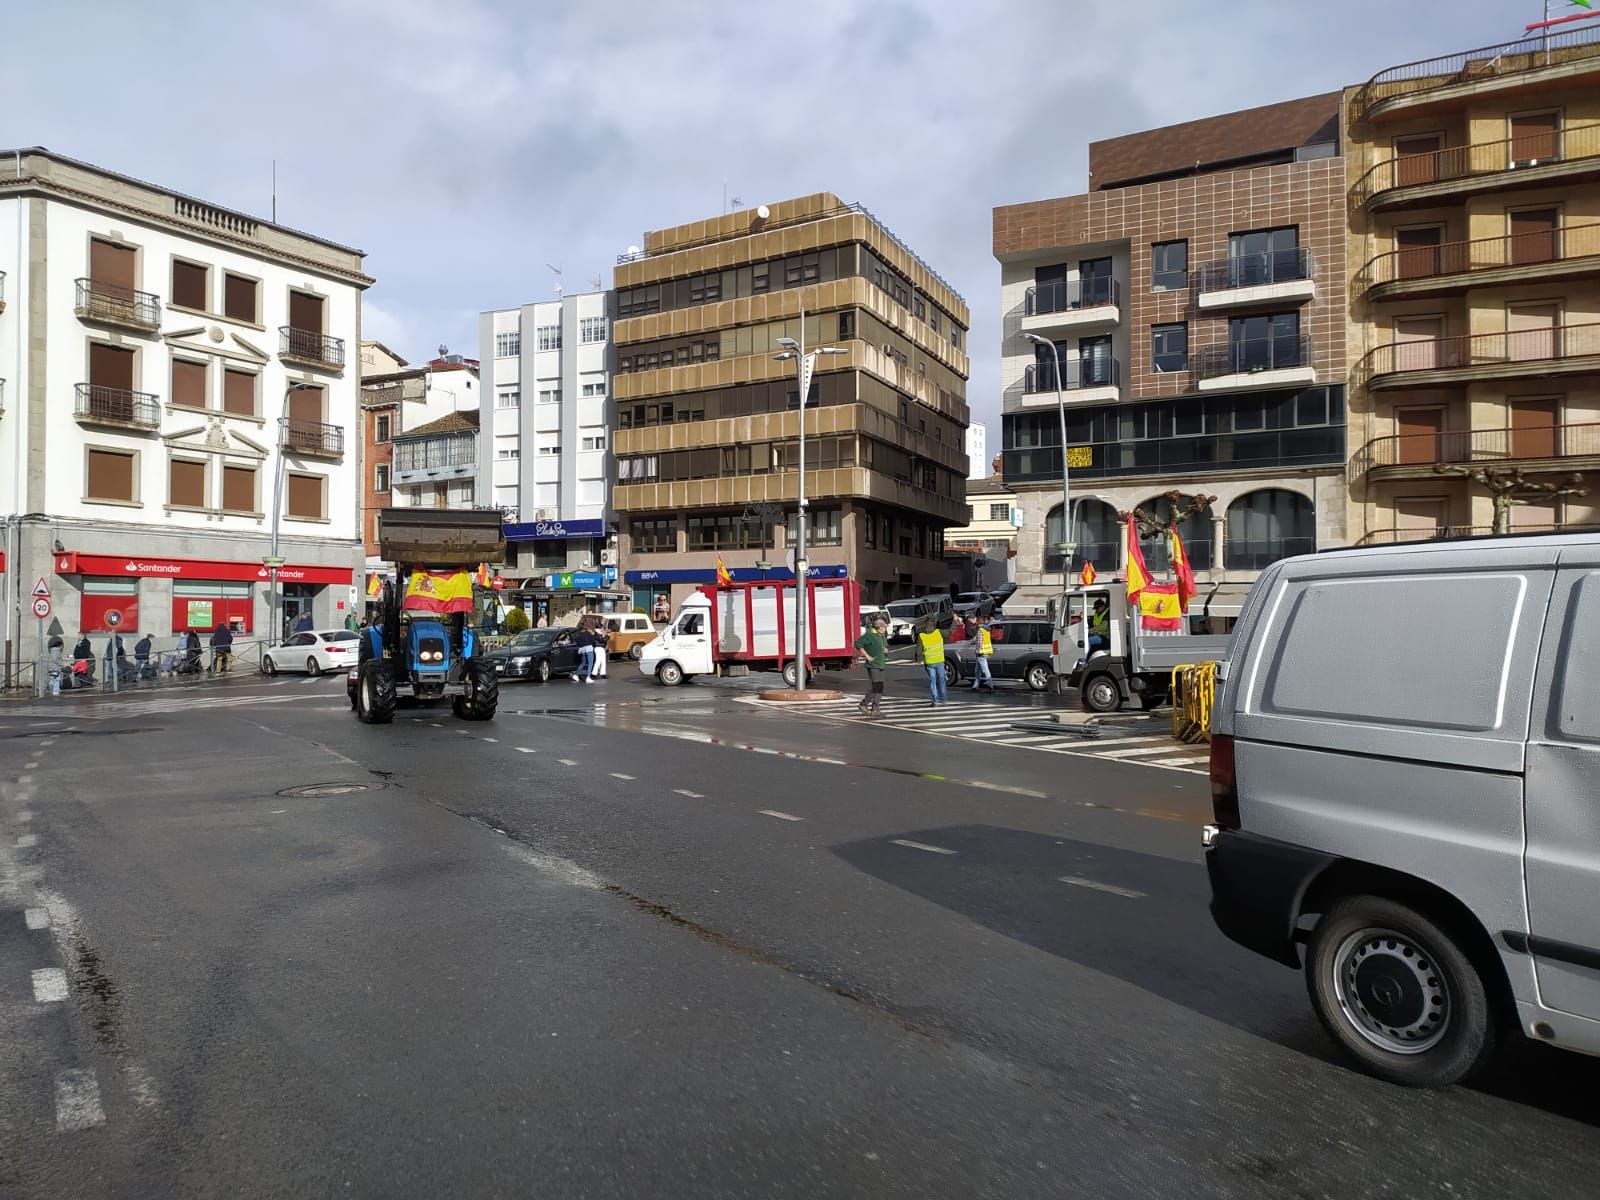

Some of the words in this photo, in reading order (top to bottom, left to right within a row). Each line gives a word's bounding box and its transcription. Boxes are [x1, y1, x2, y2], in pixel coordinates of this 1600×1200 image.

[137, 563, 182, 573] Santander
[268, 569, 305, 578] Sntander
[641, 572, 658, 580] BBVA
